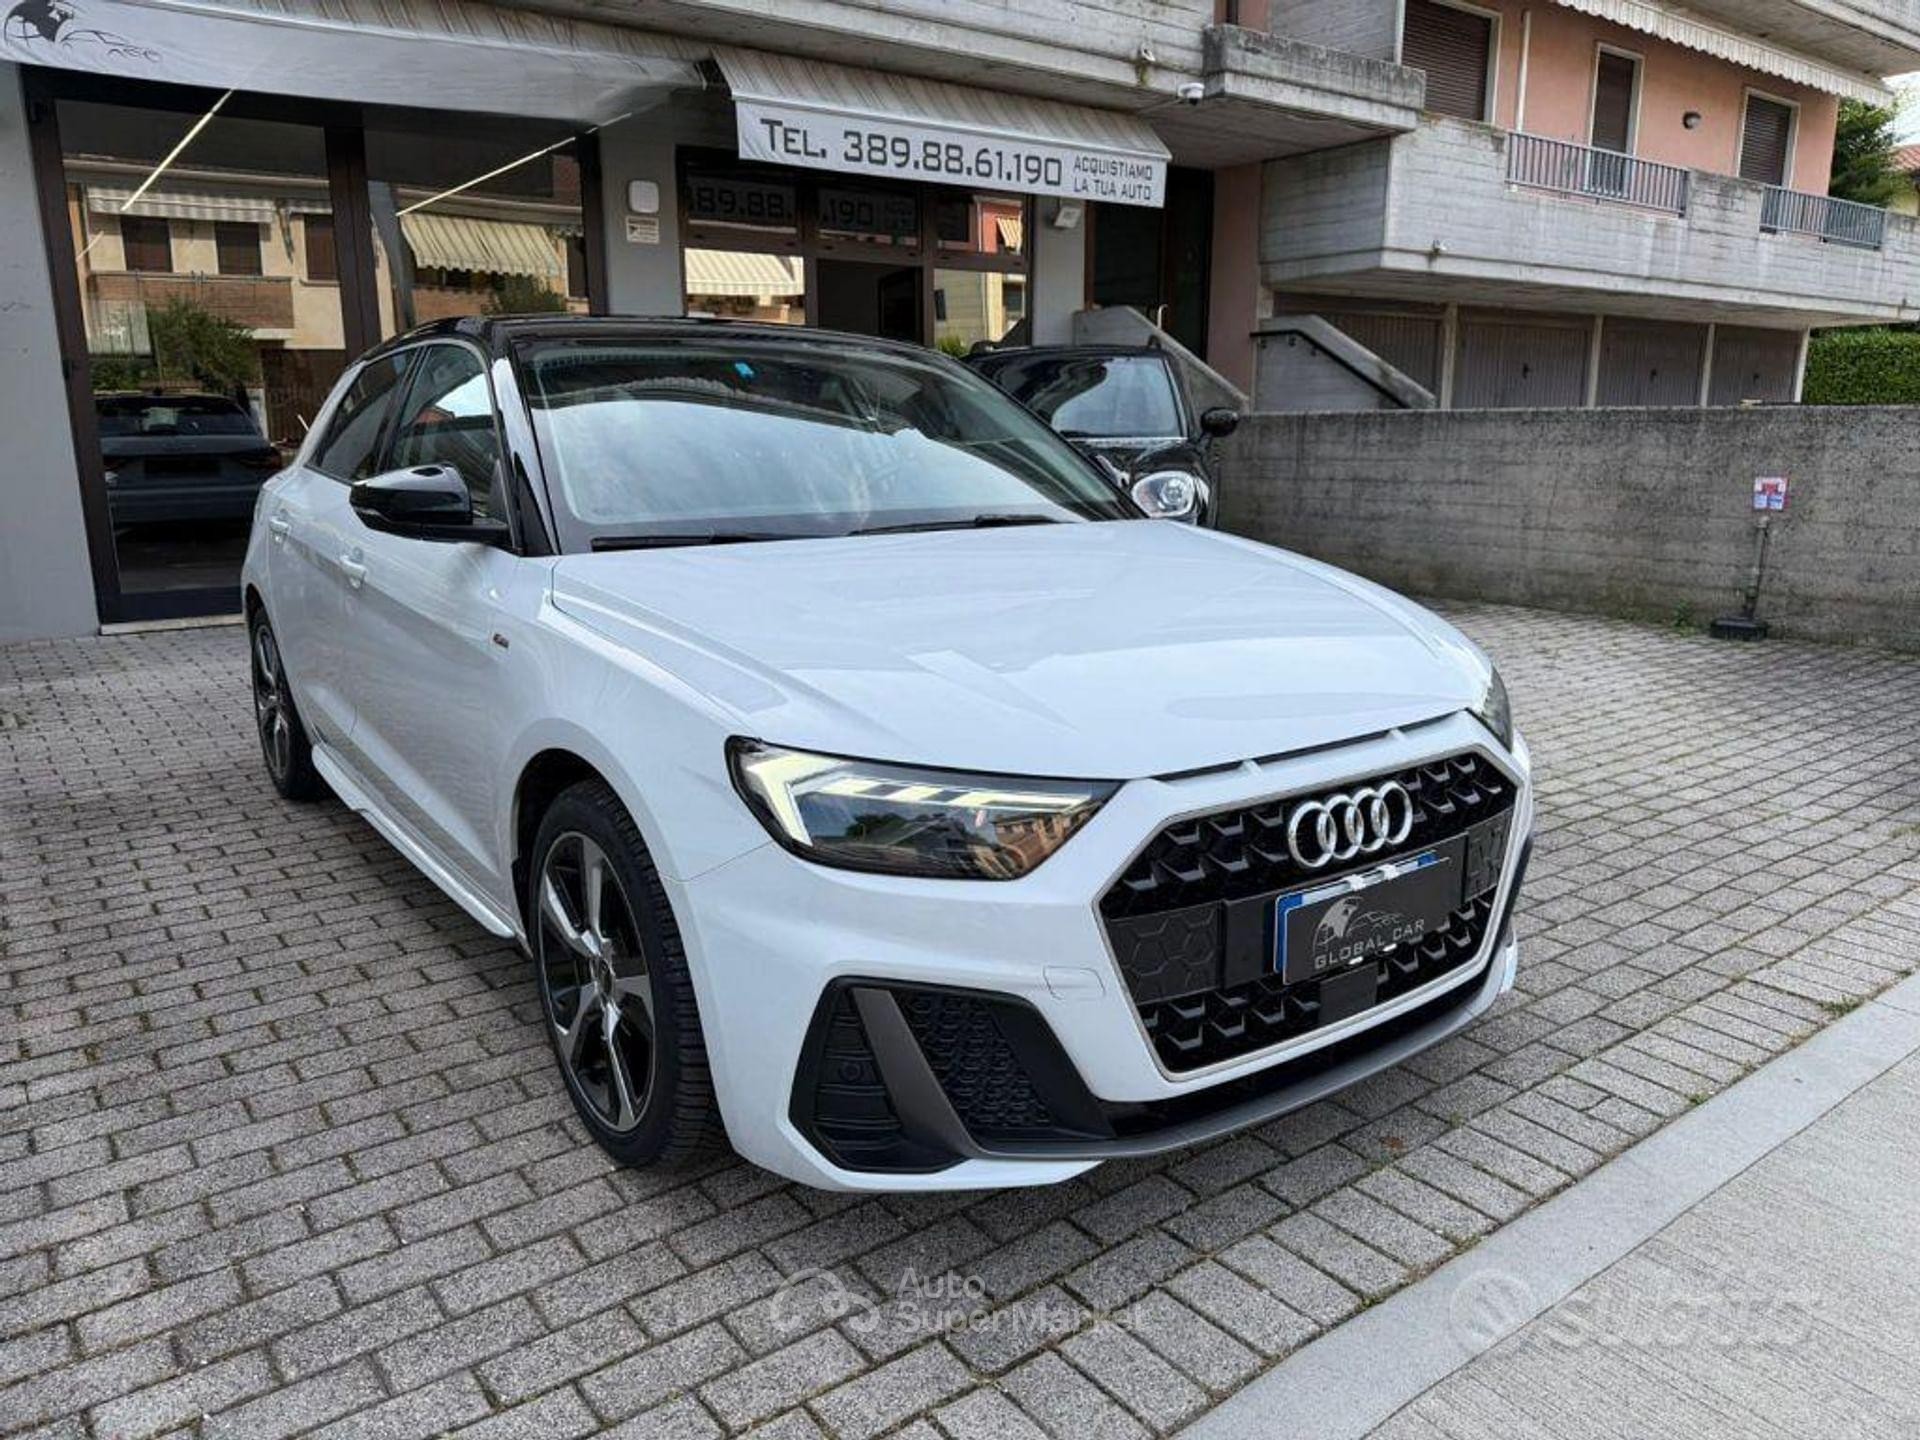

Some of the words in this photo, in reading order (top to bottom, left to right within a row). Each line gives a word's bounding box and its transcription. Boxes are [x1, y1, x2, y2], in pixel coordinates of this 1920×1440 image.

[760, 118, 827, 158] TEL.
[843, 130, 1062, 187] 389.88.61.190
[1073, 155, 1153, 181] ACQUISTIAMO
[1073, 176, 1089, 193] LA
[1093, 179, 1116, 197] TUA
[1121, 184, 1151, 201] AUTO
[1314, 934, 1386, 970] GLOBAL
[1392, 919, 1425, 942] CAR
